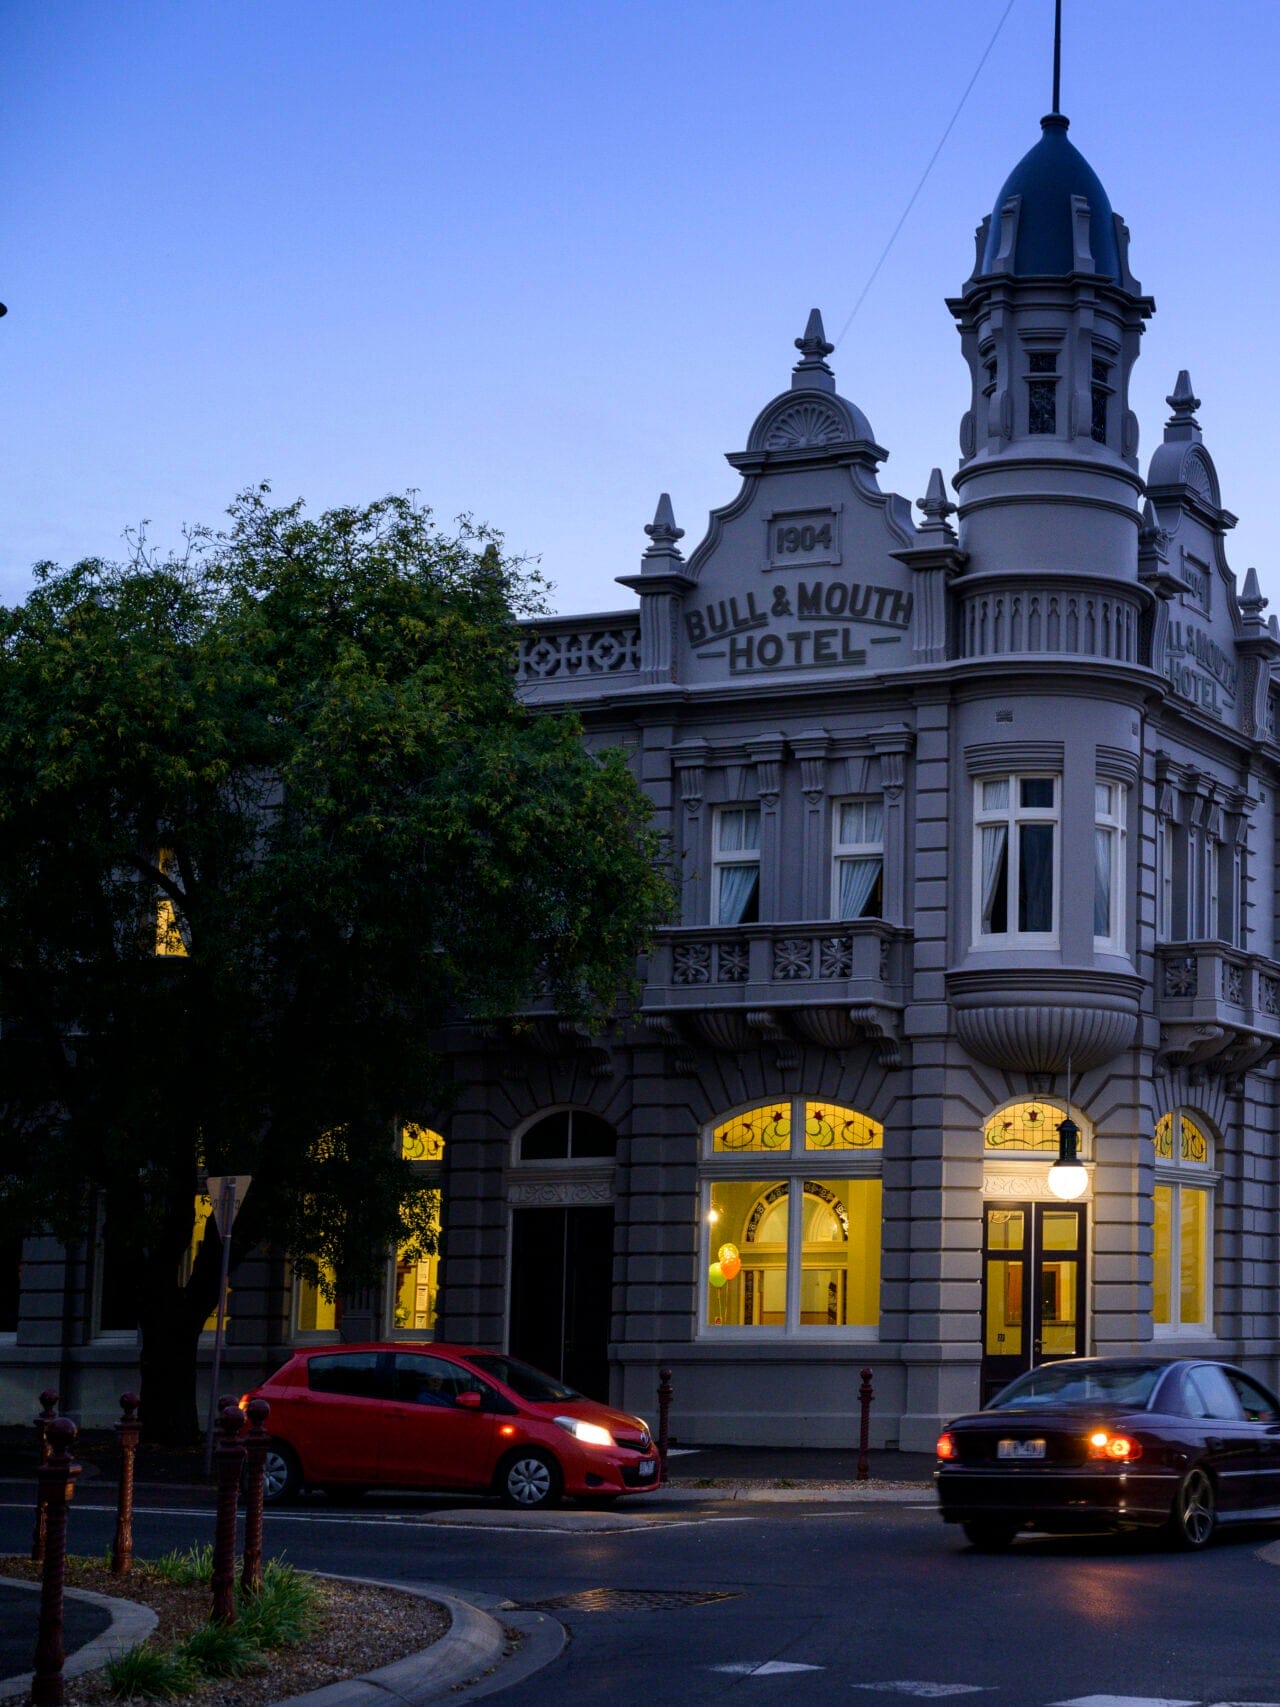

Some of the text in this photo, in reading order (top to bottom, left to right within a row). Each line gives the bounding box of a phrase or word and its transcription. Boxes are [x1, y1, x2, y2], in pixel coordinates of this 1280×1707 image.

[776, 523, 832, 554] 1904
[685, 581, 914, 643] BULL & MOUTH
[729, 627, 867, 669] HOTEL
[1169, 657, 1222, 715] HOTEL
